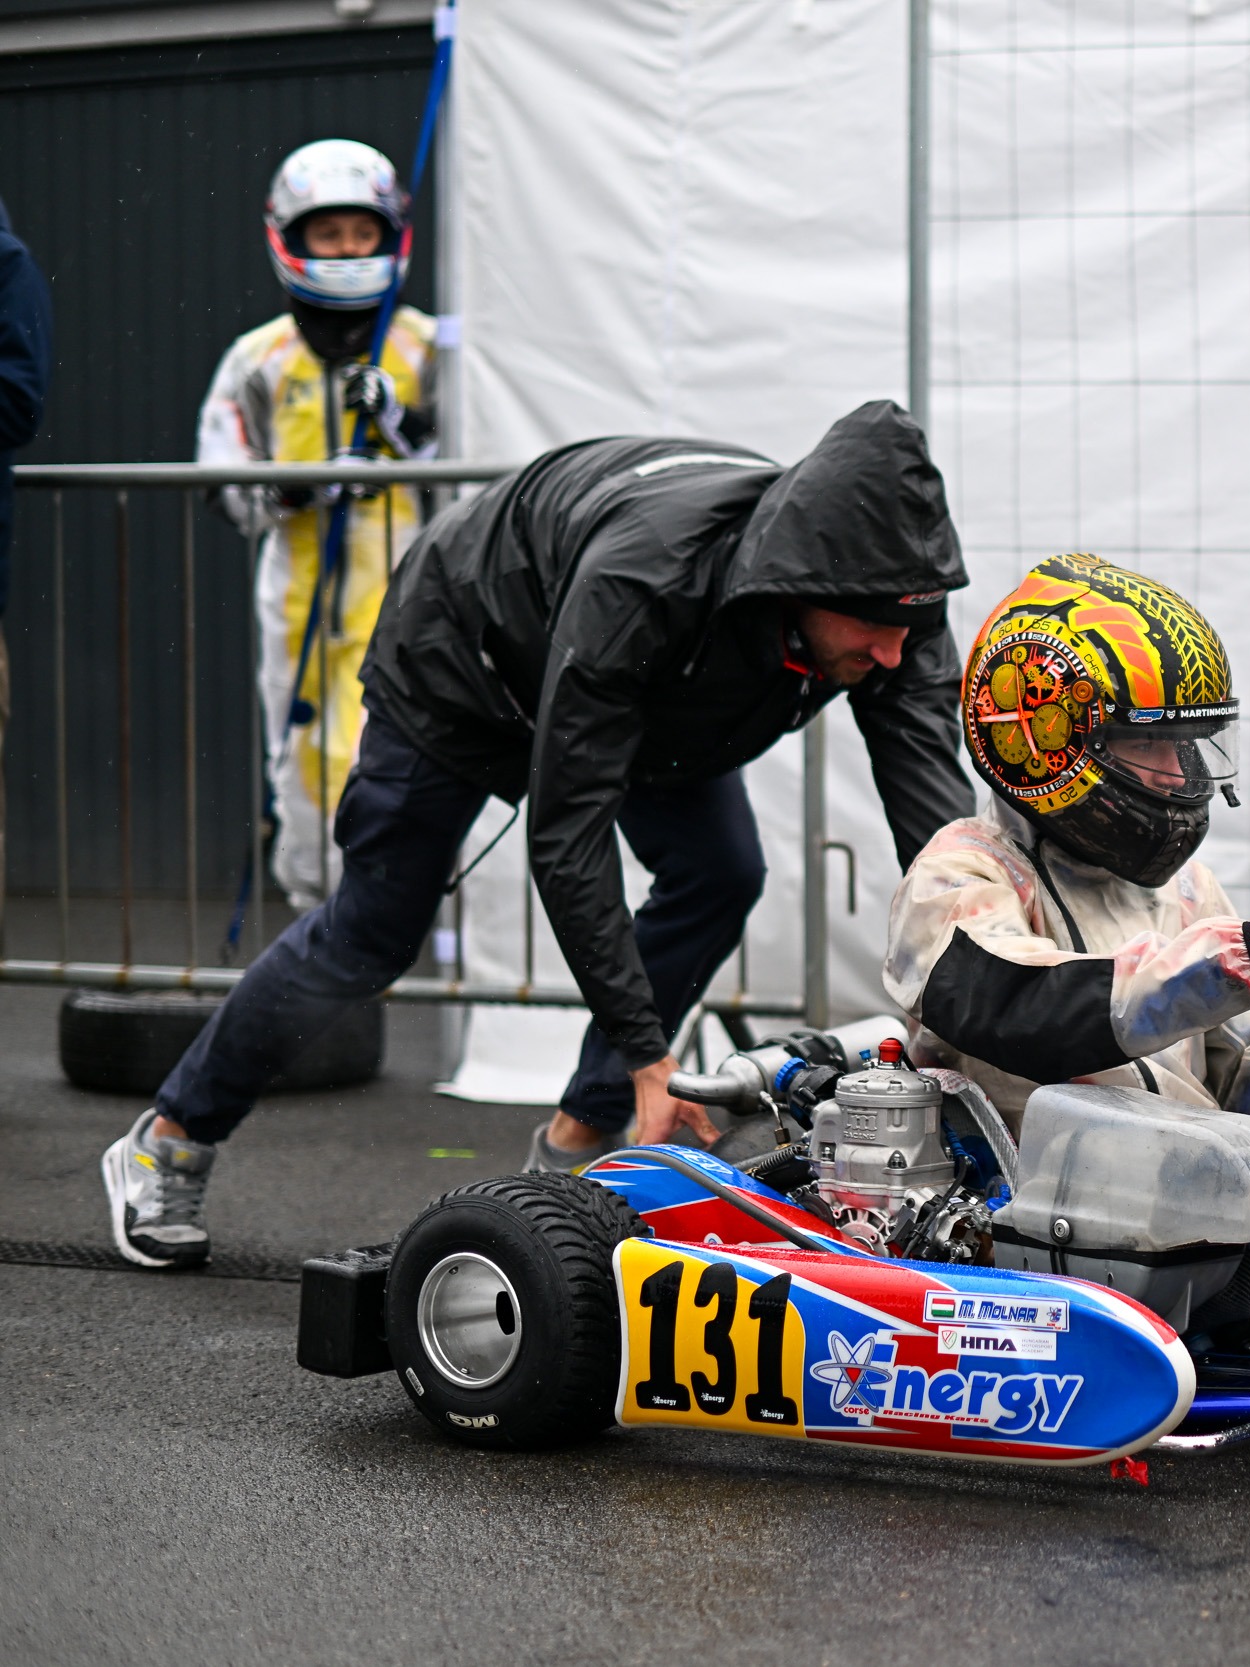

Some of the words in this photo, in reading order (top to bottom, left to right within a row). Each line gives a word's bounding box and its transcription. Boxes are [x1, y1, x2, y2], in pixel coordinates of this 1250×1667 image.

[958, 1299, 976, 1319] M.
[977, 1301, 1039, 1324] MOLNAR
[635, 1260, 798, 1426] 131
[961, 1335, 1018, 1352] HMA
[845, 1342, 1080, 1431] Energy
[652, 1396, 677, 1406] Energy
[701, 1392, 726, 1403] Energy
[760, 1409, 785, 1420] Energy
[843, 1405, 871, 1415] corse
[883, 1409, 941, 1420] Racing
[943, 1415, 990, 1424] Karts
[449, 1413, 496, 1428] MG
